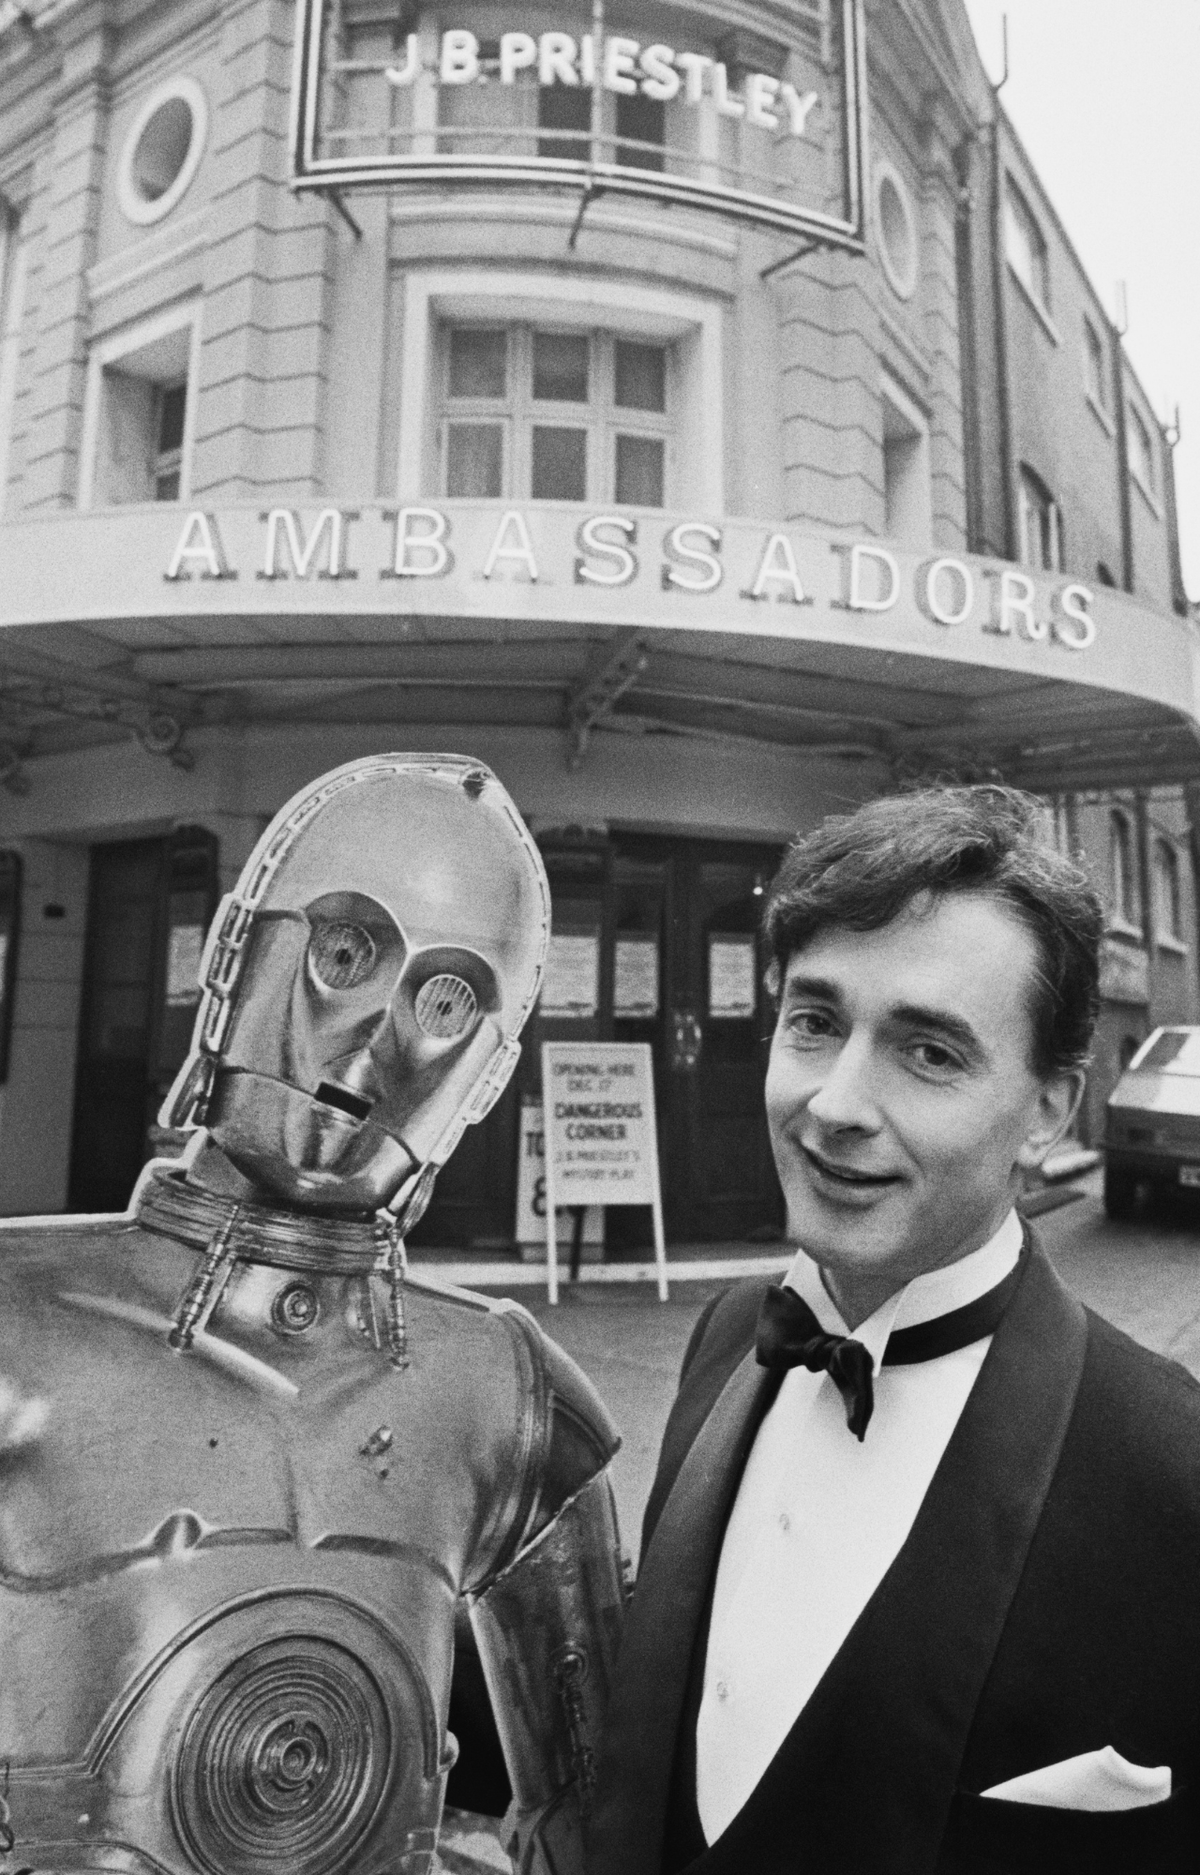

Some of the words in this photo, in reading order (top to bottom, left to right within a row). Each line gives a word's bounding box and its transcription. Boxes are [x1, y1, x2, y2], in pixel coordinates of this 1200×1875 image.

[500, 31, 820, 136] PRIESTLEY
[163, 506, 1098, 650] AMBASSADORS
[554, 1101, 643, 1120] DANGEROUS
[565, 1122, 627, 1141] CORNER
